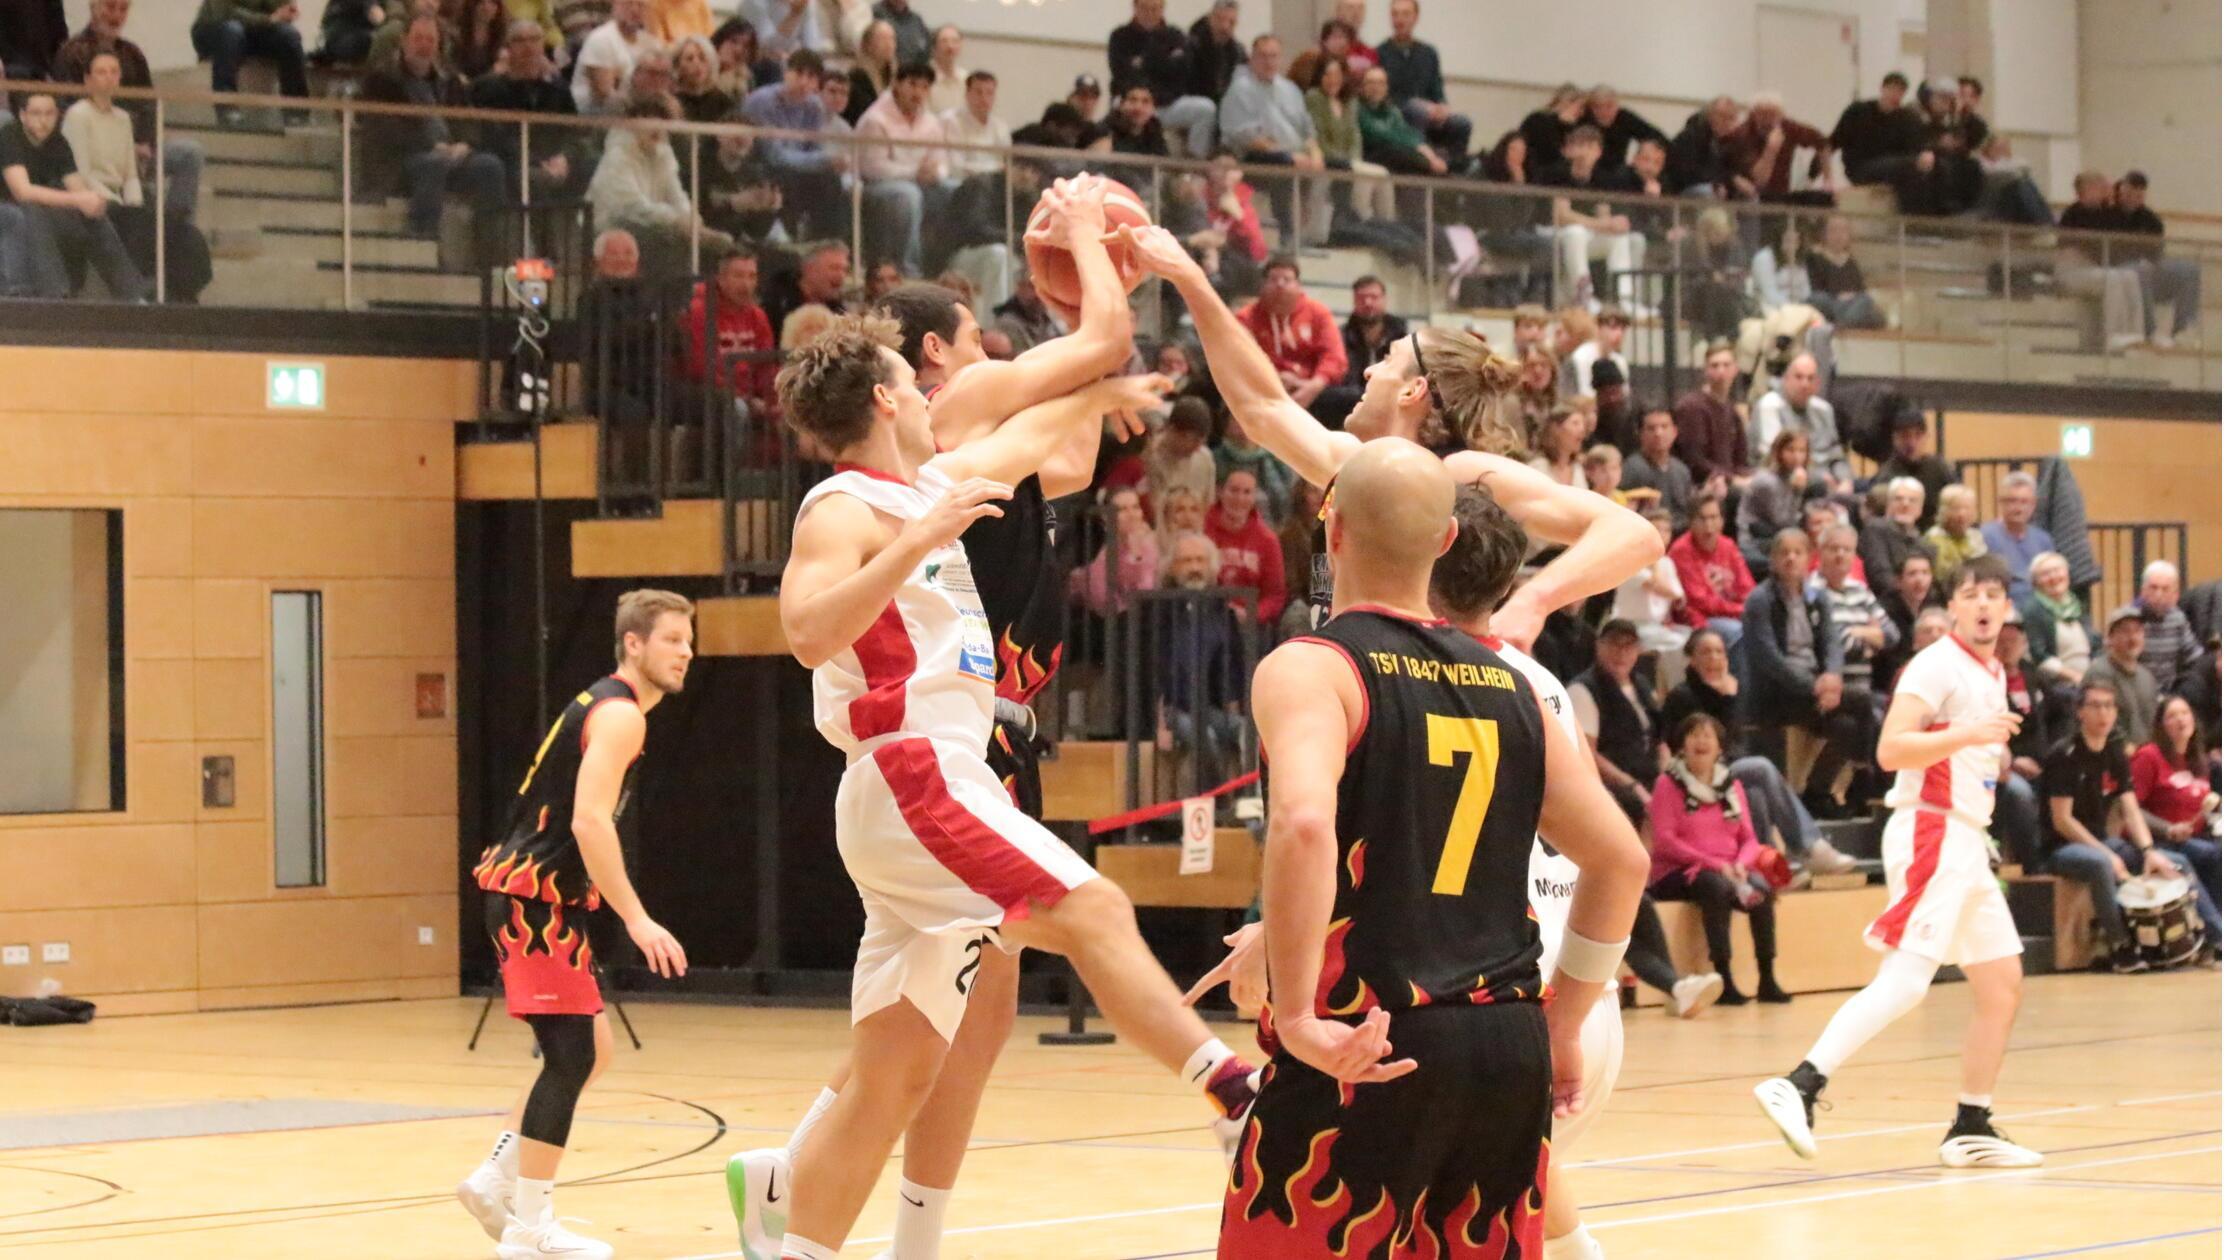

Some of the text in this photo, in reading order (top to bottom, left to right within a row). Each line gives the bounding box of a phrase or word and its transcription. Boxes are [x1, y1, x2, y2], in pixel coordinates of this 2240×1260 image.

[1369, 652, 1516, 692] TSV 1847 WEILHEIM
[1426, 713, 1500, 896] 7
